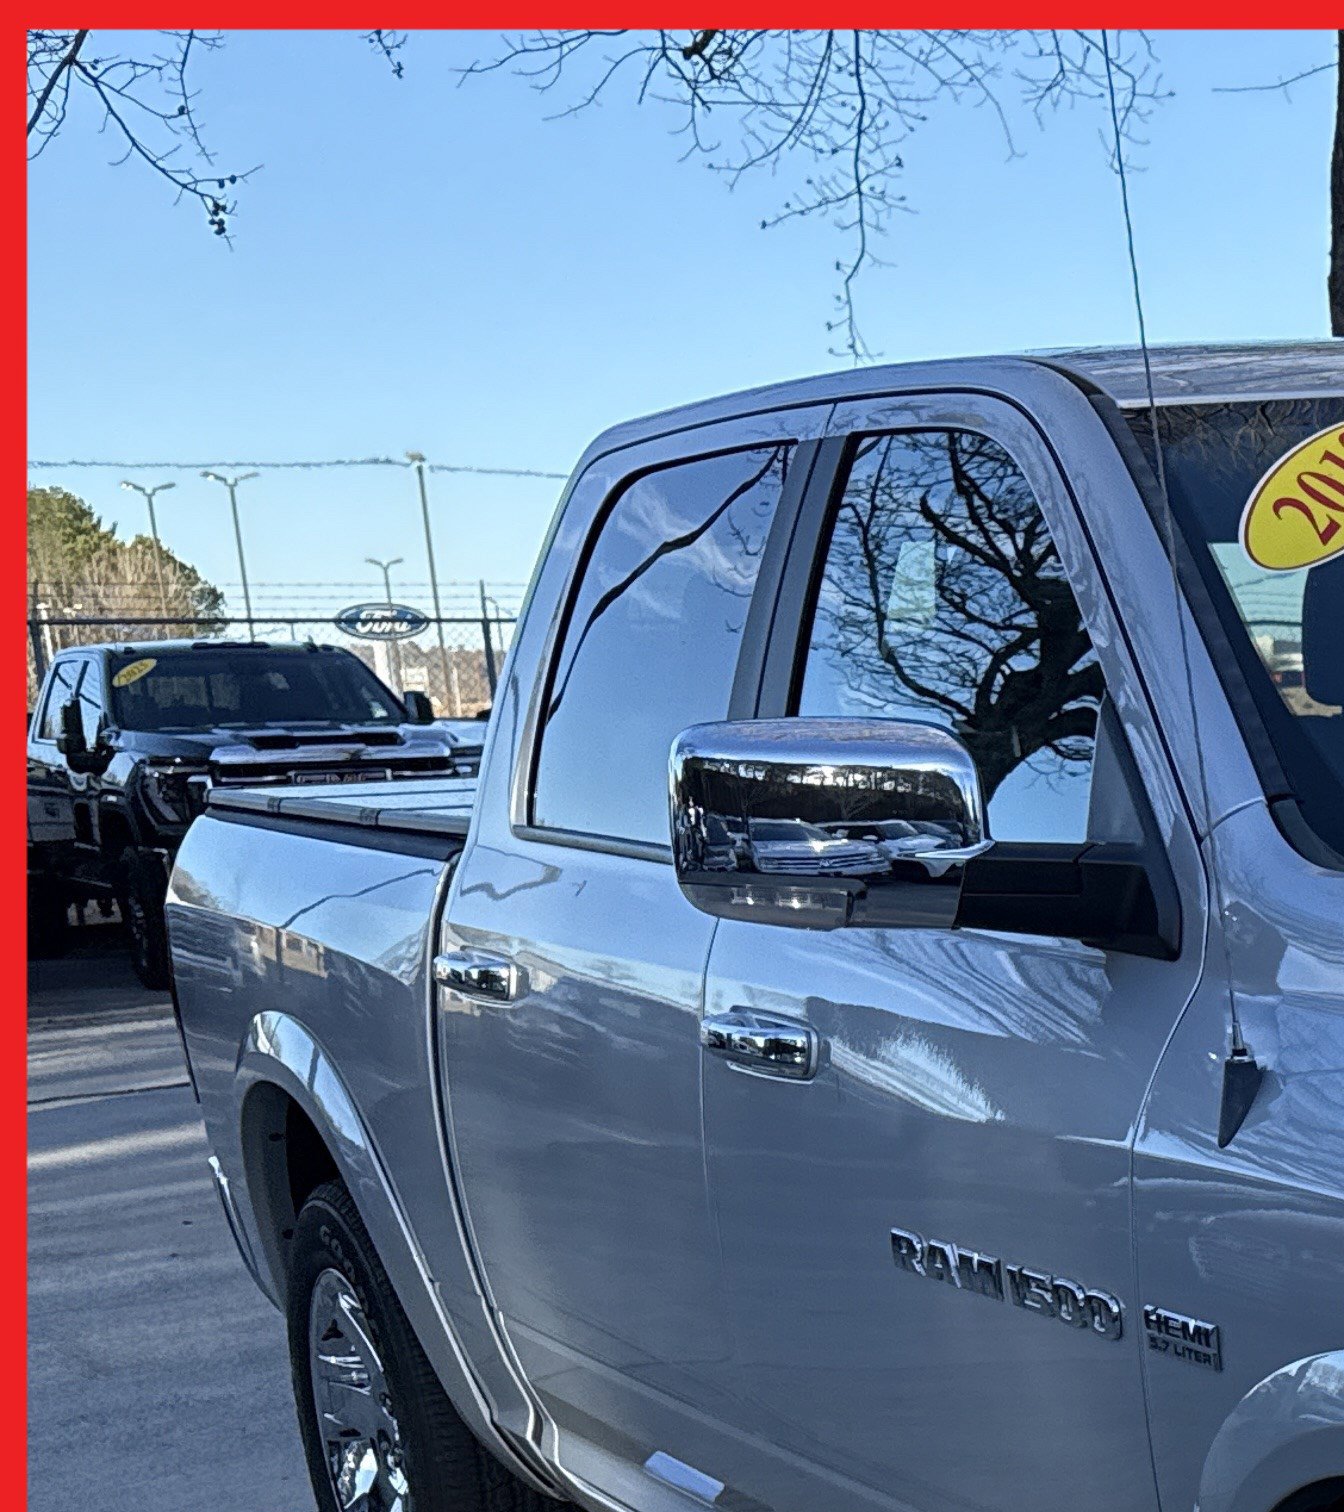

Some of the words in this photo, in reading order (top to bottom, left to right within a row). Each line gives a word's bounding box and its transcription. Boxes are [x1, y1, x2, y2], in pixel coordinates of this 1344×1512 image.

[356, 610, 412, 634] Ford
[889, 1227, 1004, 1302] RAM
[1005, 1263, 1125, 1341] 1500
[1143, 1304, 1222, 1371] HEMI
